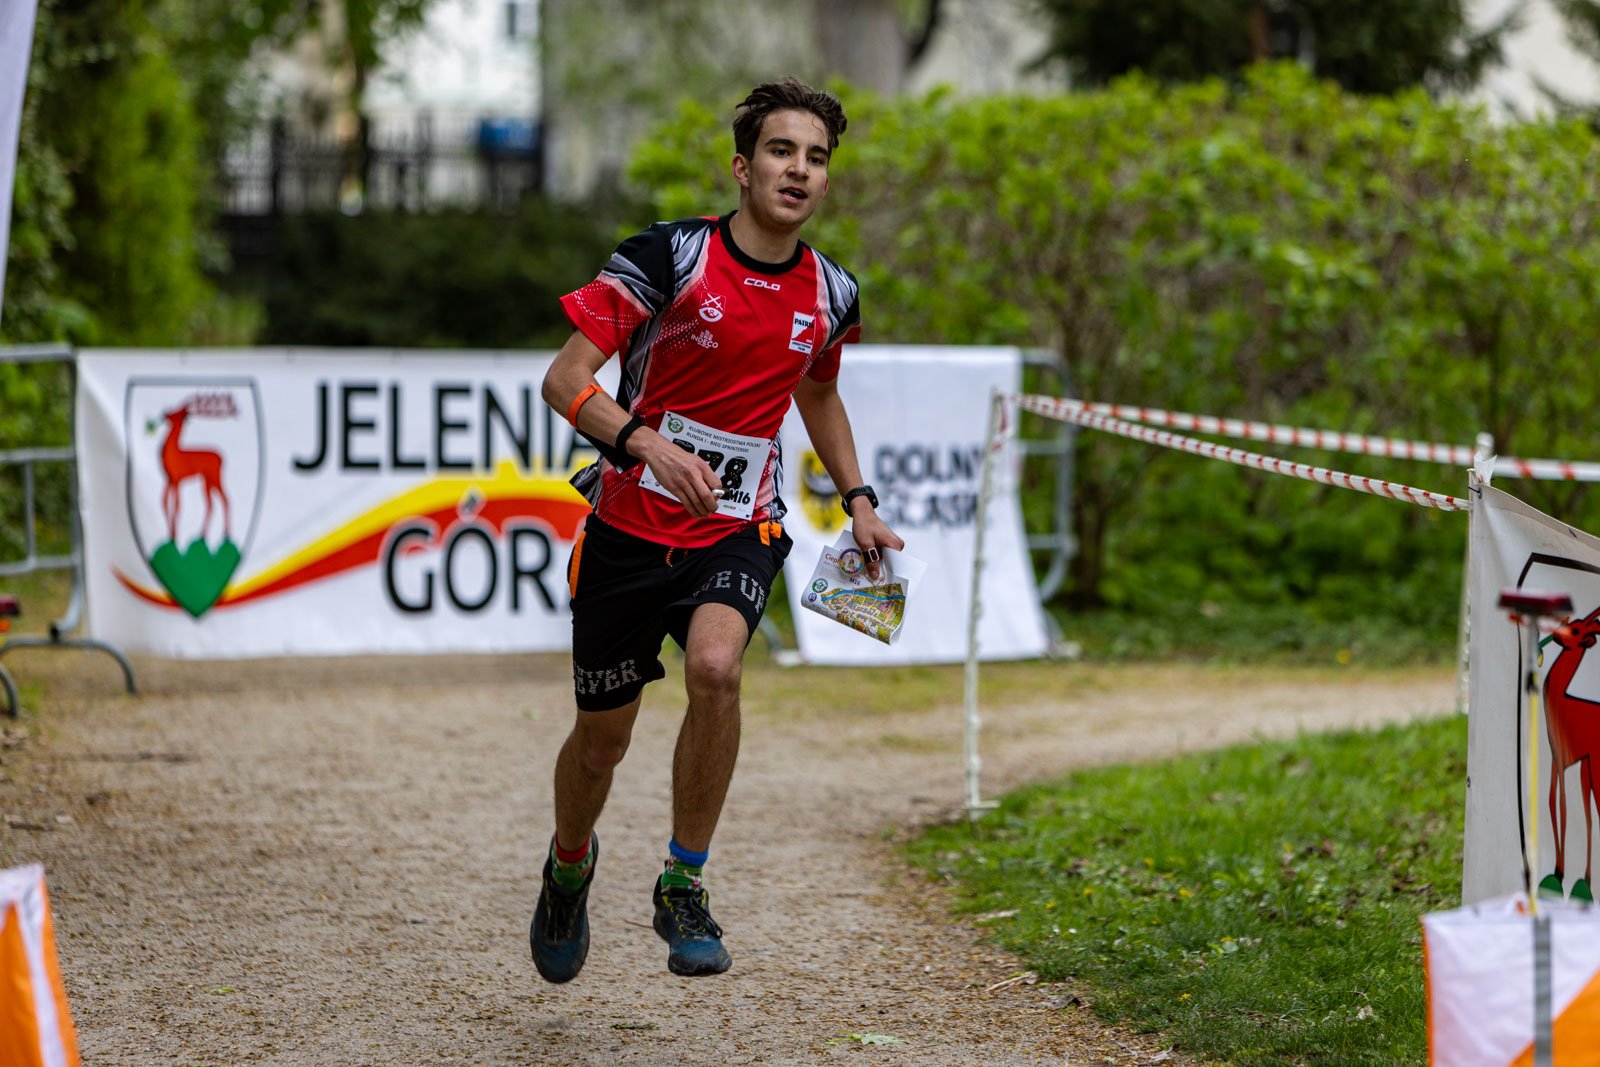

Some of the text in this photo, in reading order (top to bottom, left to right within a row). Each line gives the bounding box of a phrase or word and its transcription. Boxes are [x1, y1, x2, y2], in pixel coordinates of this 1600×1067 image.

[743, 277, 781, 291] COLO
[690, 333, 719, 349] INDECO
[686, 431, 704, 443] RUNDA
[709, 440, 721, 448] BIEG
[721, 444, 750, 453] SPRINTERSKI
[688, 425, 712, 439] KLUBOWE
[712, 434, 746, 446] MISTRZOSTWA
[729, 489, 751, 505] M16
[384, 492, 571, 614] GÓR
[574, 658, 642, 695] EVER
